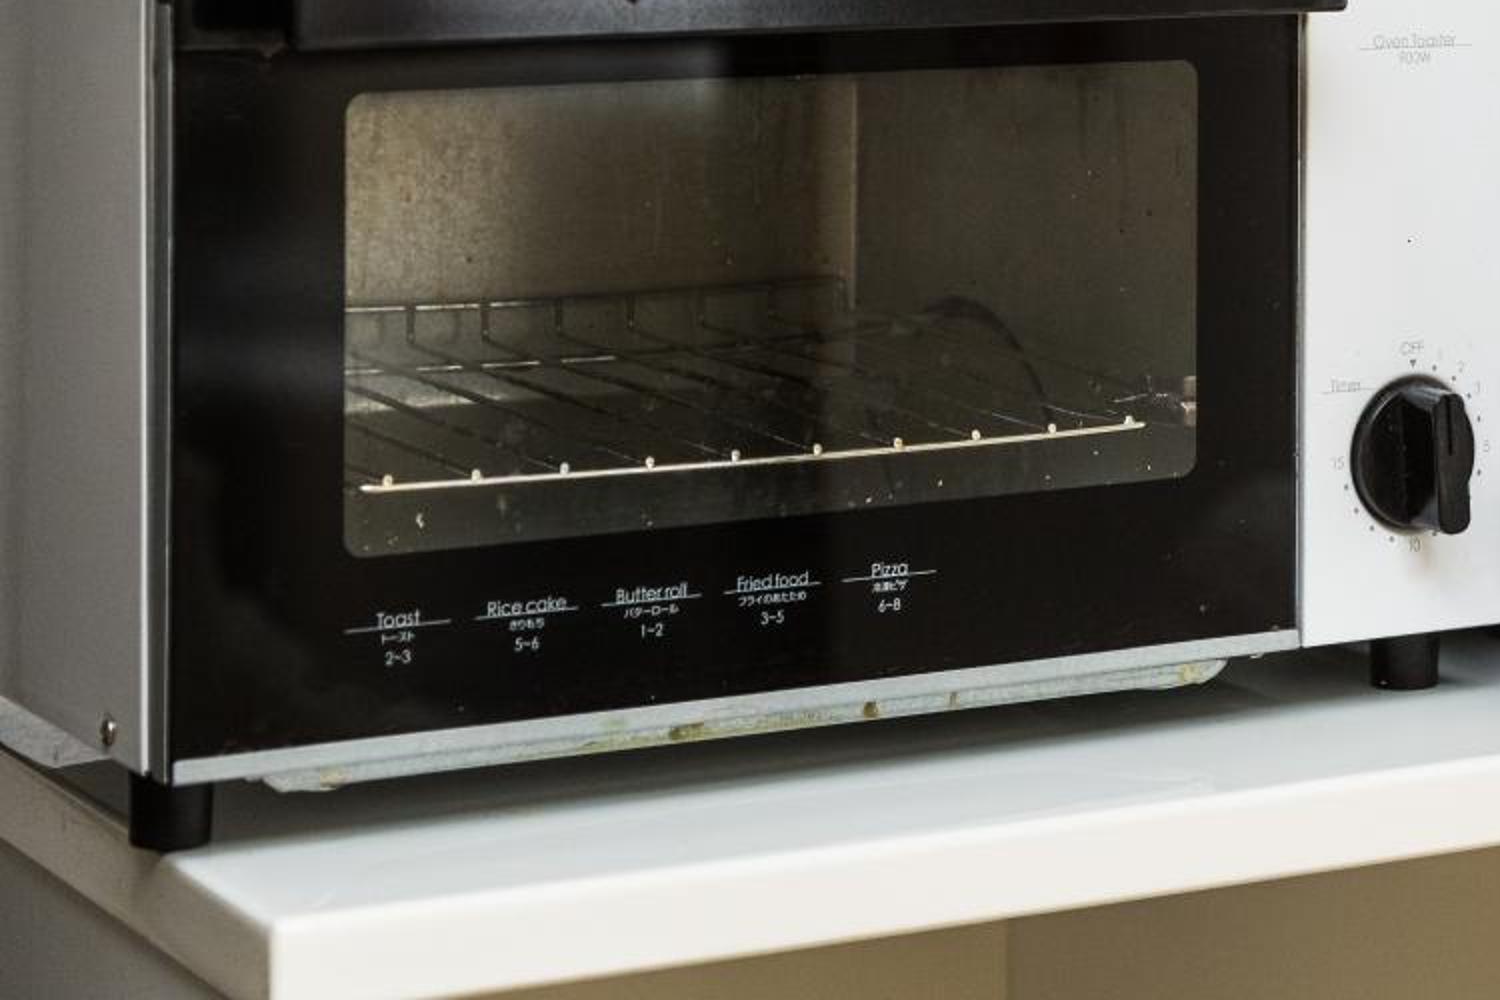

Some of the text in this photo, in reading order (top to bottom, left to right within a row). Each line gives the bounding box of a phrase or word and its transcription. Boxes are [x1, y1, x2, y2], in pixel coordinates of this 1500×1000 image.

[871, 562, 909, 578] Pizza
[616, 581, 688, 605] Butter roll
[737, 571, 809, 593] Fried food
[487, 595, 568, 617] Rice cake
[376, 608, 421, 629] Toast
